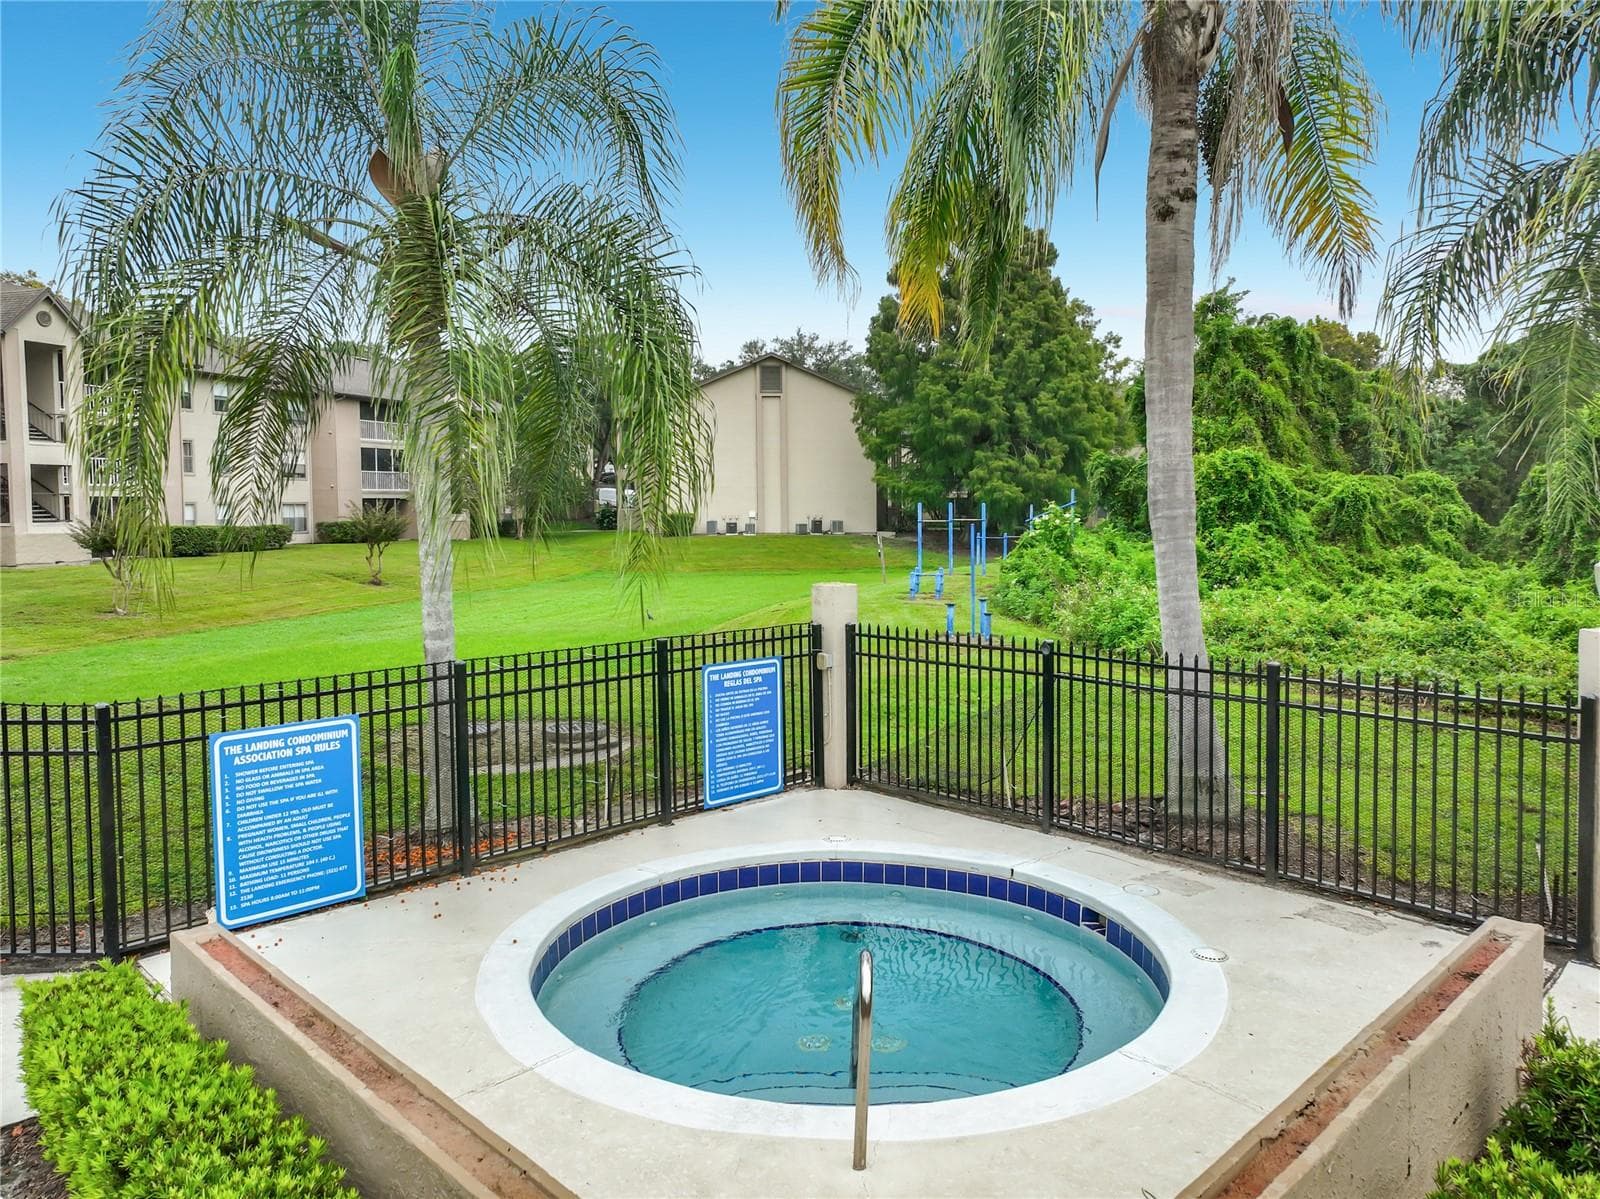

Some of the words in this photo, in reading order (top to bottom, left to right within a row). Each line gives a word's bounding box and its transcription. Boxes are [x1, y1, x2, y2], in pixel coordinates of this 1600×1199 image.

[721, 671, 741, 680] LANDING
[743, 667, 775, 677] CONDOMINIUM
[724, 679, 742, 687] REGLAS
[224, 745, 243, 756] THE
[244, 739, 285, 752] LANDING
[287, 730, 348, 746] CONDOMINIUM
[234, 748, 293, 765] ASSOCIATION
[295, 745, 312, 756] SPA
[314, 741, 340, 753] RULES
[280, 762, 304, 770] ENTERING
[270, 776, 298, 785] BEVERAGES
[258, 785, 283, 794] SWALLOW
[237, 810, 263, 818] DIARRHEA
[237, 816, 263, 825] CHILDREN
[238, 821, 275, 832] ACCOMPANIED
[238, 830, 265, 839] PREGNANT
[265, 837, 293, 847] NARCOTICS
[239, 852, 255, 860] CAUSE
[257, 845, 289, 856] DROWSINESS
[291, 841, 310, 849] SHOULD
[239, 857, 264, 866] WITHOUT
[265, 850, 296, 861] CONSULTING
[240, 863, 268, 873] MAXIMUM
[240, 870, 268, 880] MAXIMUM
[269, 862, 304, 874] TEMPERATURE
[240, 878, 263, 887] BATHING
[287, 868, 309, 877] PERSONS
[251, 882, 274, 891] LANDING
[276, 875, 305, 886] EMERGENCY
[251, 897, 269, 905] HOURS
